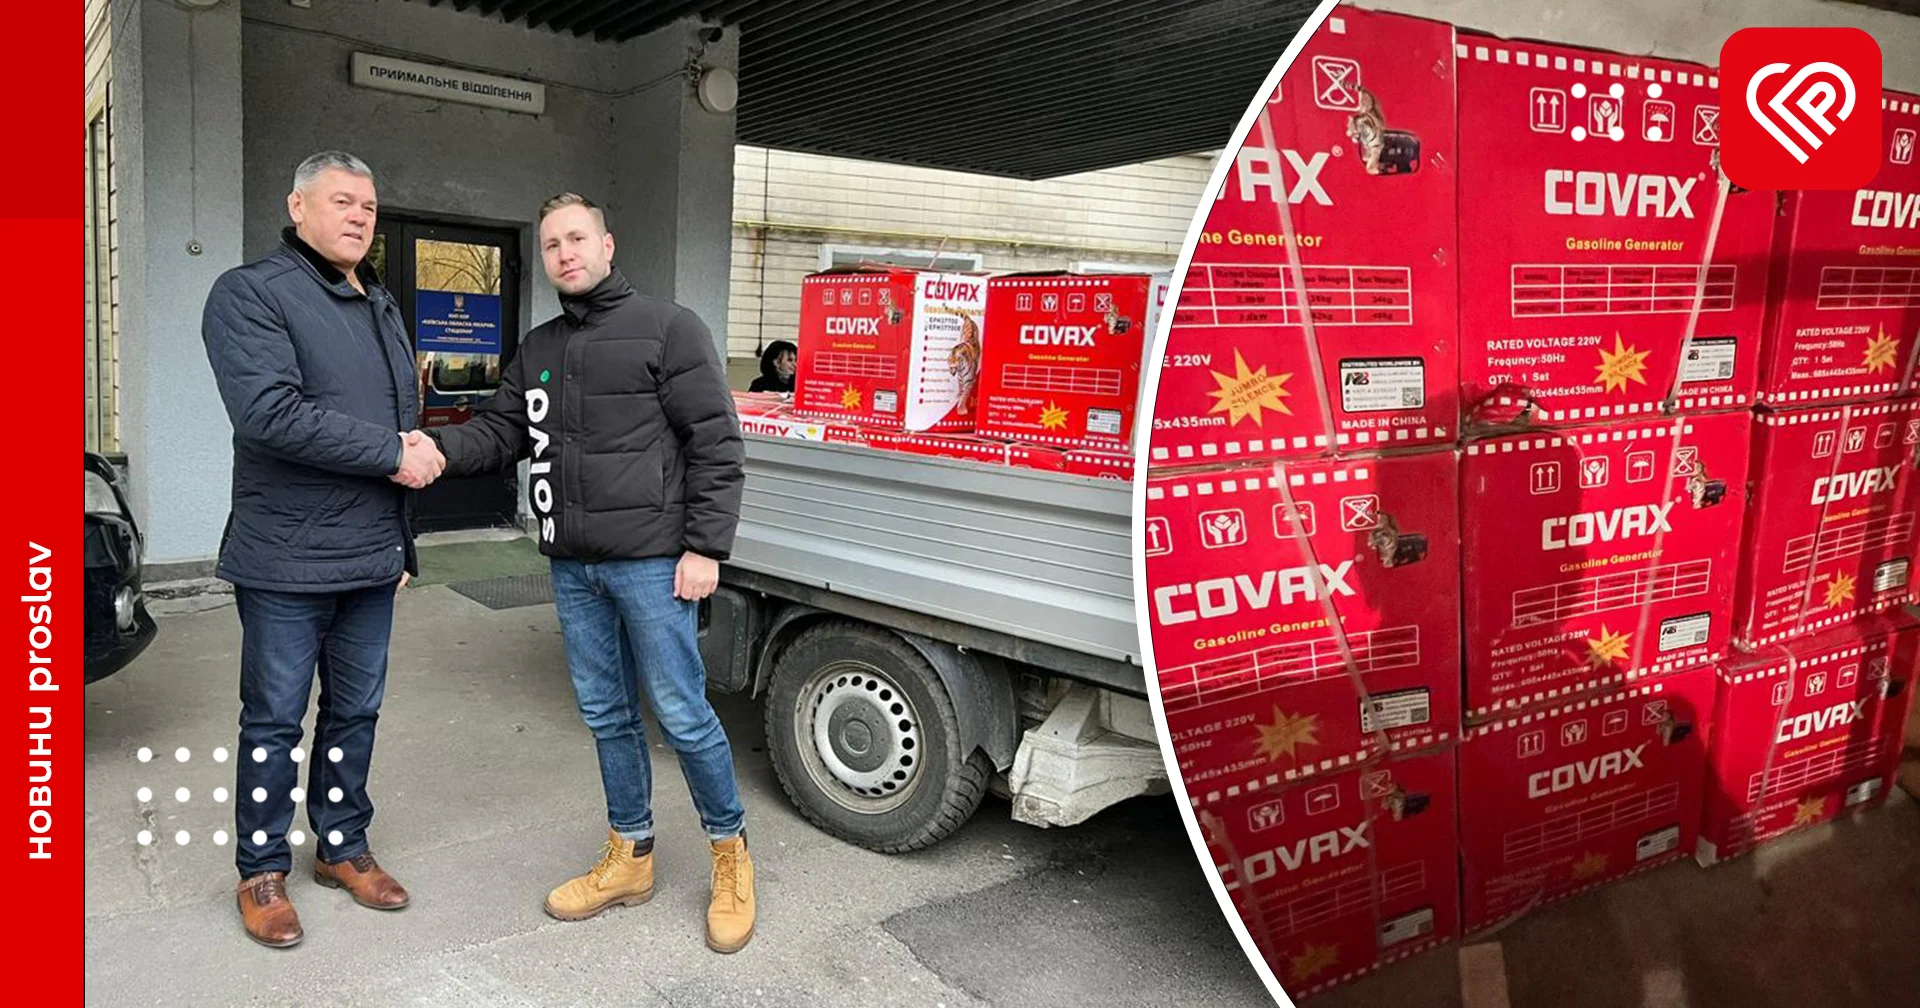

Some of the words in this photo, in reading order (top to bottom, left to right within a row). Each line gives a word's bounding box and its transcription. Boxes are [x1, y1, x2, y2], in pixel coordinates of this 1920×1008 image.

[369, 65, 459, 90] ПРИЙМАЛЬНЕ
[1545, 168, 1698, 219] COVAX
[1565, 236, 1622, 251] Gasoline
[1624, 237, 1685, 252] Generator
[924, 280, 980, 302] COVAX
[826, 316, 880, 336] COVAX
[1019, 324, 1096, 347] COVAX
[1487, 339, 1523, 351] RATED
[1525, 336, 1576, 350] VOLTAGE
[1577, 335, 1602, 346] 220V
[1173, 353, 1212, 368] 220V
[1488, 373, 1513, 386] QTY:
[1531, 372, 1550, 384] Set
[1341, 419, 1376, 430] MADE
[1377, 418, 1390, 429] IN
[1391, 415, 1427, 427] CHINA
[1811, 465, 1900, 506] COVAX
[1542, 501, 1675, 551] COVAX
[1559, 557, 1608, 574] Gasoline
[1610, 549, 1665, 565] Generator
[1154, 560, 1356, 627] COVAX
[1192, 626, 1267, 651] Gasoline
[1491, 645, 1523, 657] RATED
[1524, 633, 1566, 649] VOLTAGE
[1776, 695, 1866, 744] COVAX
[1528, 743, 1646, 799] COVAX
